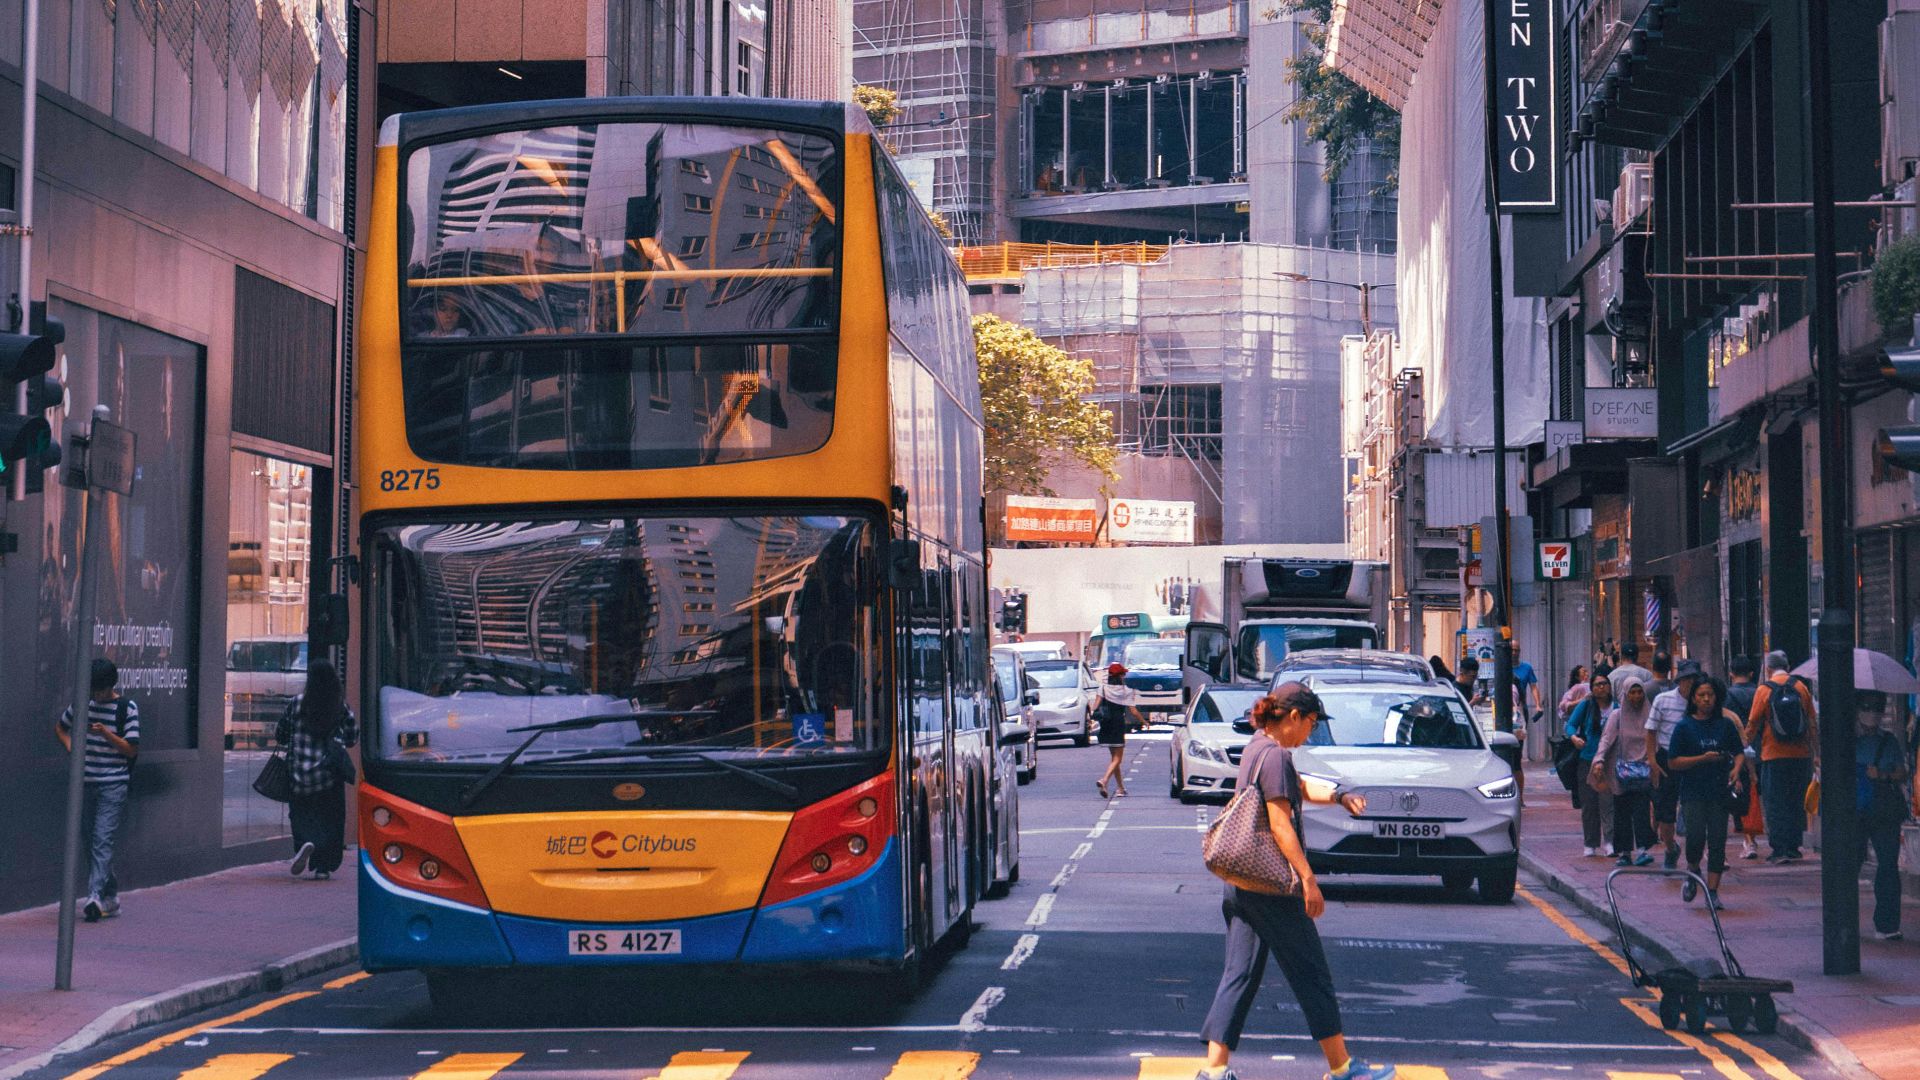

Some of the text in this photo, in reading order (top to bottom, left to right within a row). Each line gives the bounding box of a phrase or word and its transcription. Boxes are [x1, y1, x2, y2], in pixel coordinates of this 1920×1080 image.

[1505, 77, 1540, 173] TWO
[1607, 417, 1640, 426] STUDIO
[380, 468, 441, 492] 8275
[104, 624, 120, 653] your
[120, 618, 144, 656] culinary
[146, 620, 173, 654] creativity
[152, 660, 188, 696] intelligence
[1378, 823, 1440, 837] WN 8689
[545, 835, 587, 855] 城巴
[621, 834, 697, 854] Citybus
[577, 932, 673, 951] RS 4127
